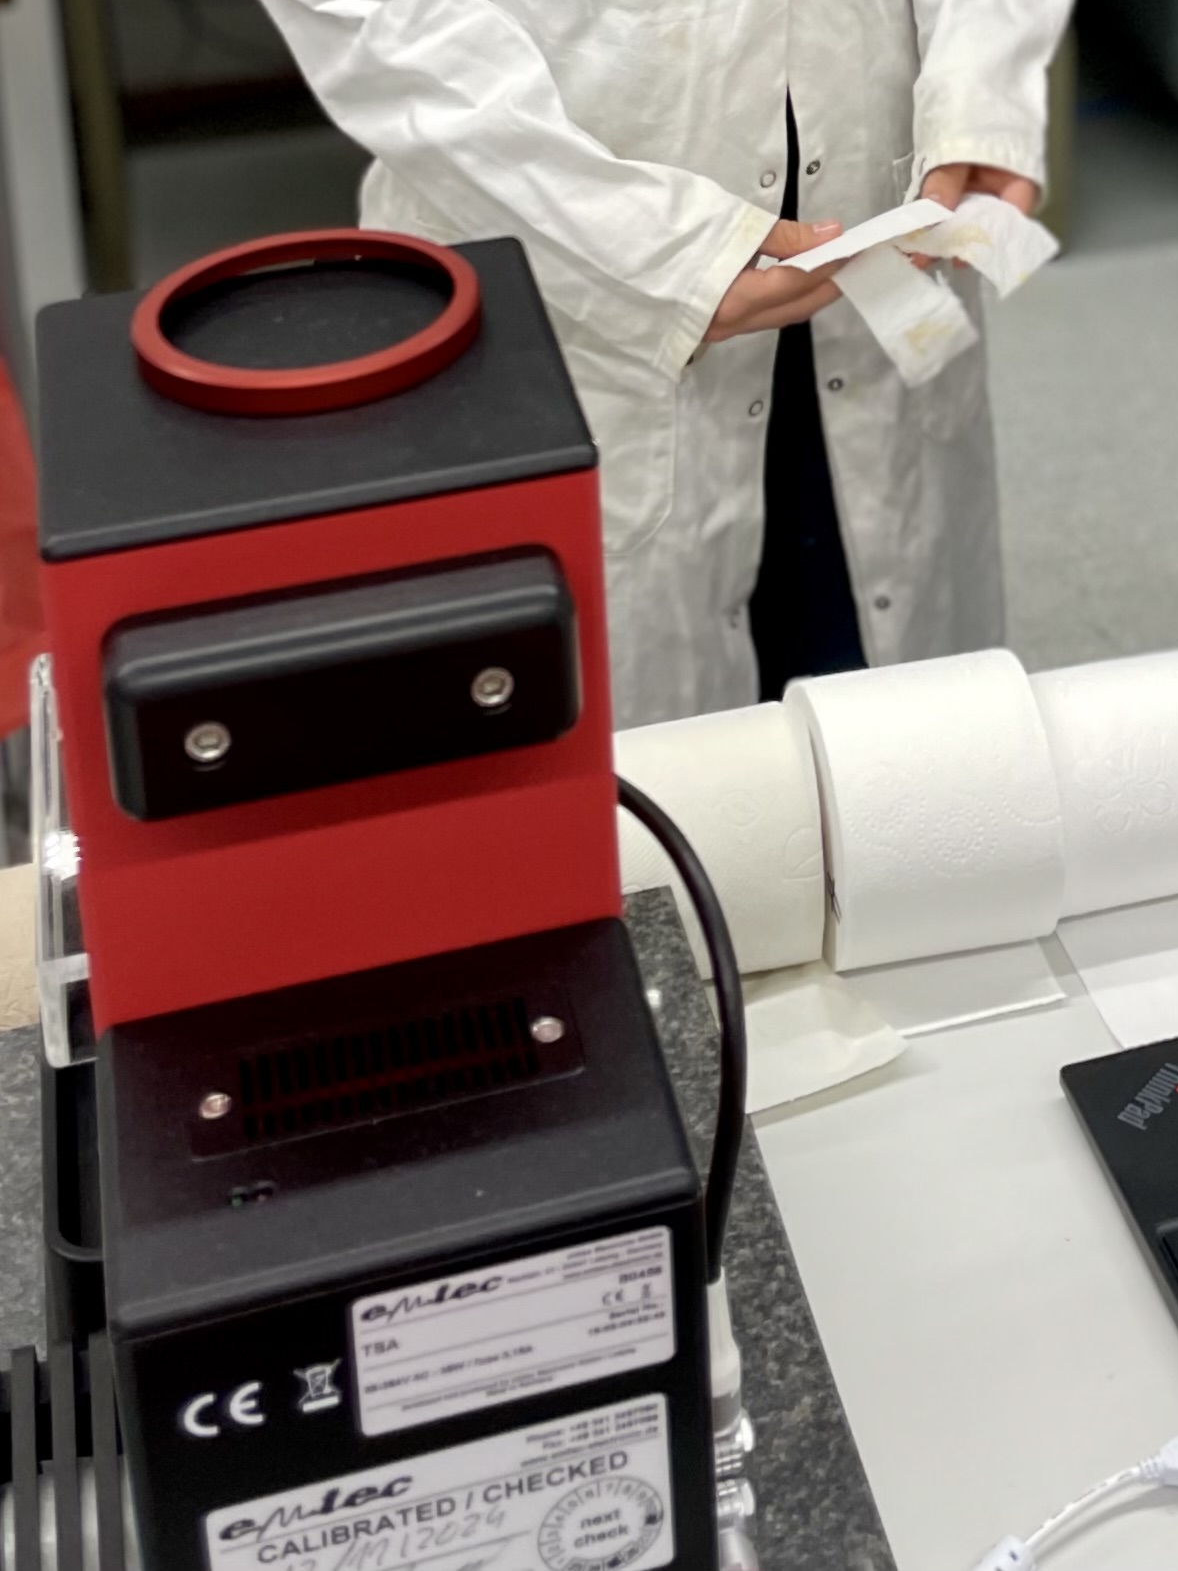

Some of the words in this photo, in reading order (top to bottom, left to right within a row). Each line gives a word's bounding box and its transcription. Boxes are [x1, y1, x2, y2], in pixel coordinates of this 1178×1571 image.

[257, 1496, 457, 1564] CALIBRATED
[482, 1450, 630, 1504] CHECKED
[580, 1508, 621, 1530] next
[573, 1524, 629, 1549] check
